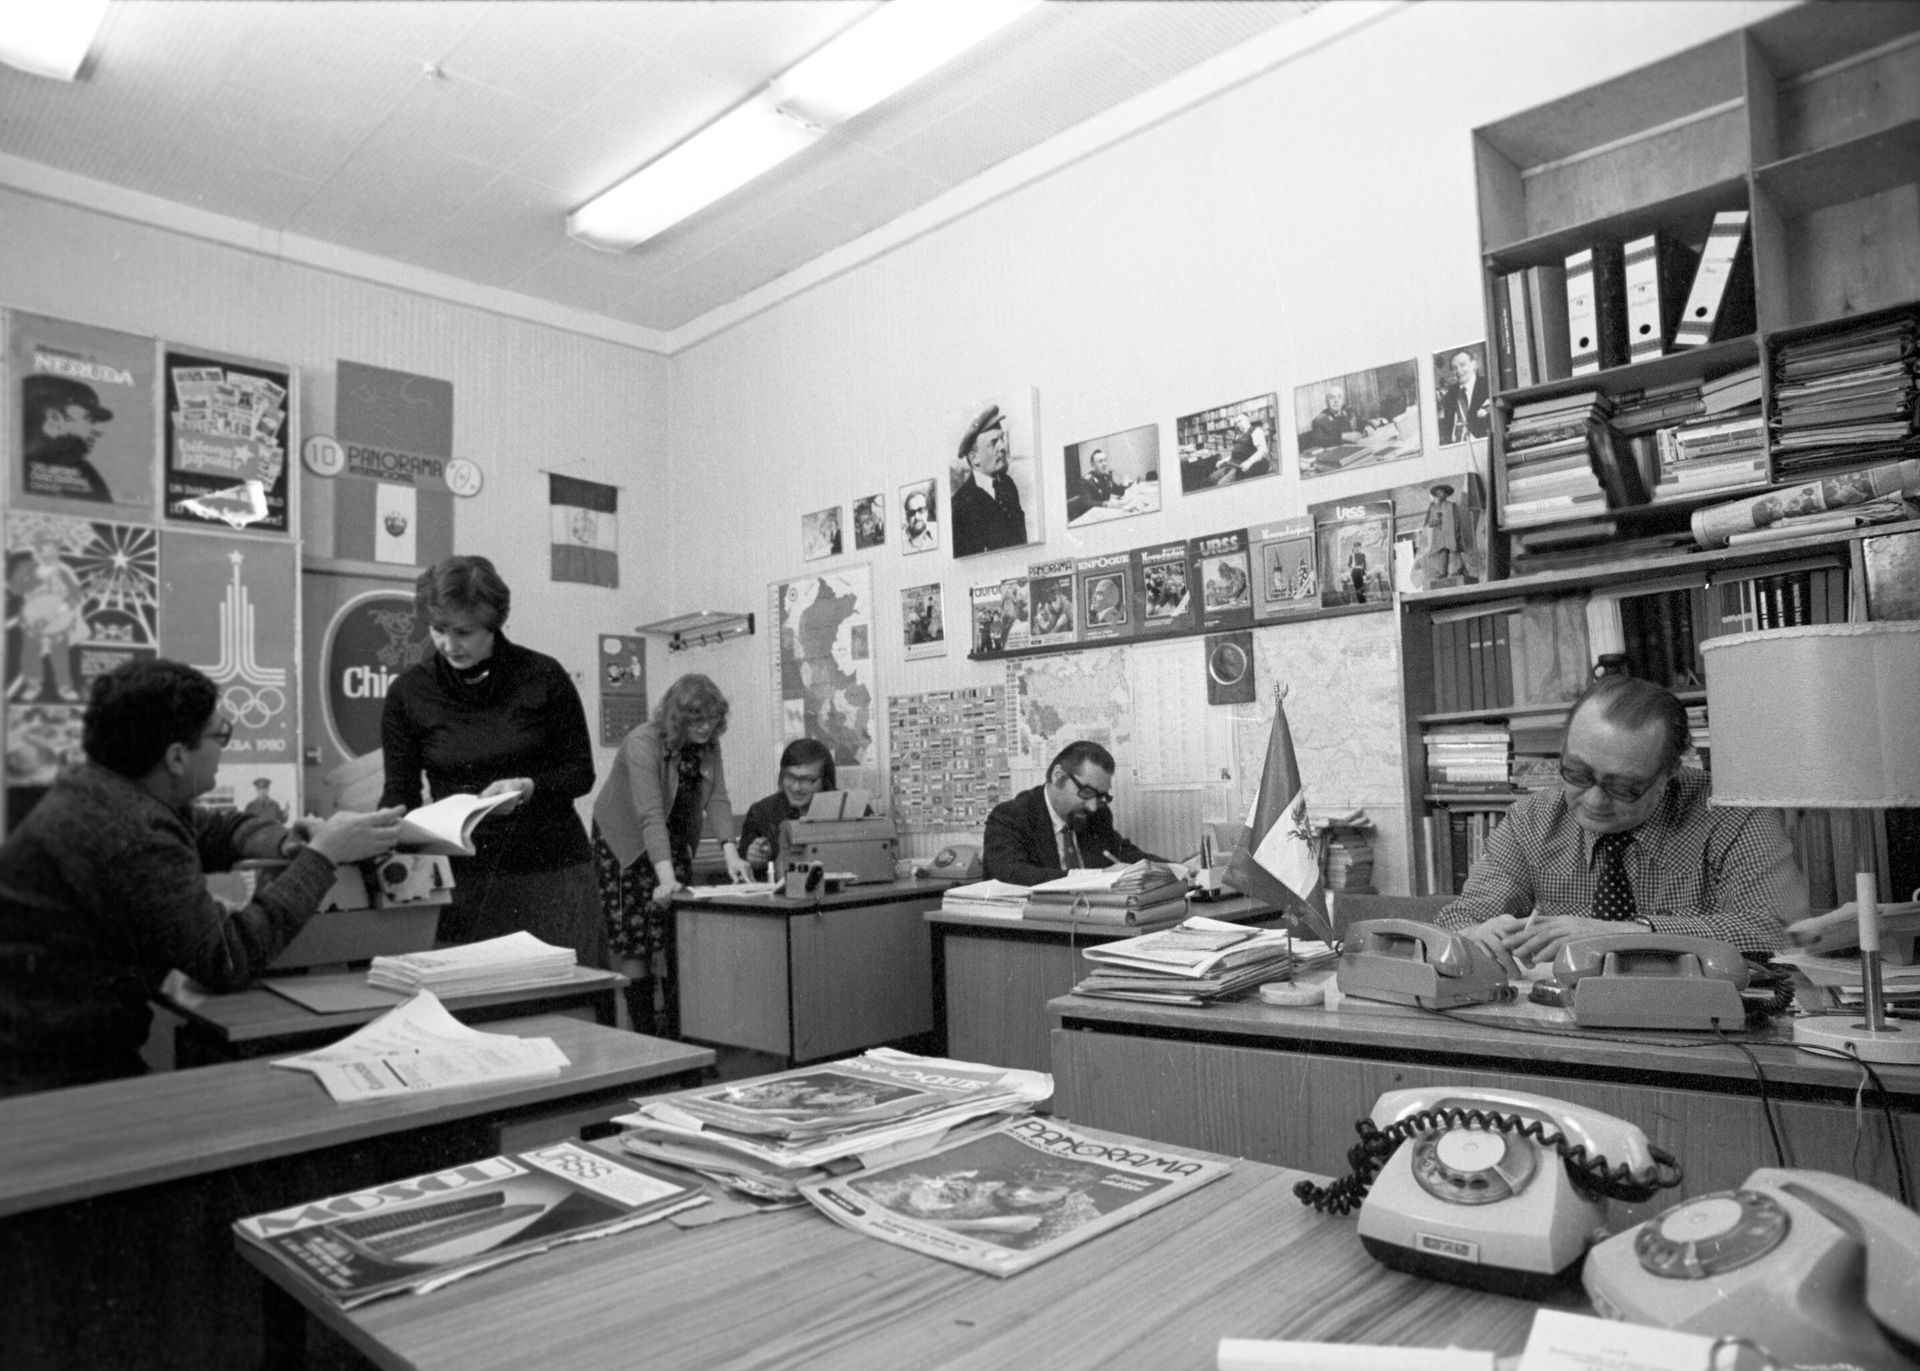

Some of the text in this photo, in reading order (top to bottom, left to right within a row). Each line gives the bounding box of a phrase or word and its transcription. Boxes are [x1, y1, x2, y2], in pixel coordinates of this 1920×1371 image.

[347, 446, 443, 478] PANORAMA
[1199, 535, 1239, 557] URSS
[1028, 560, 1073, 577] PANORAMA
[1013, 1119, 1204, 1177] PANORAMA
